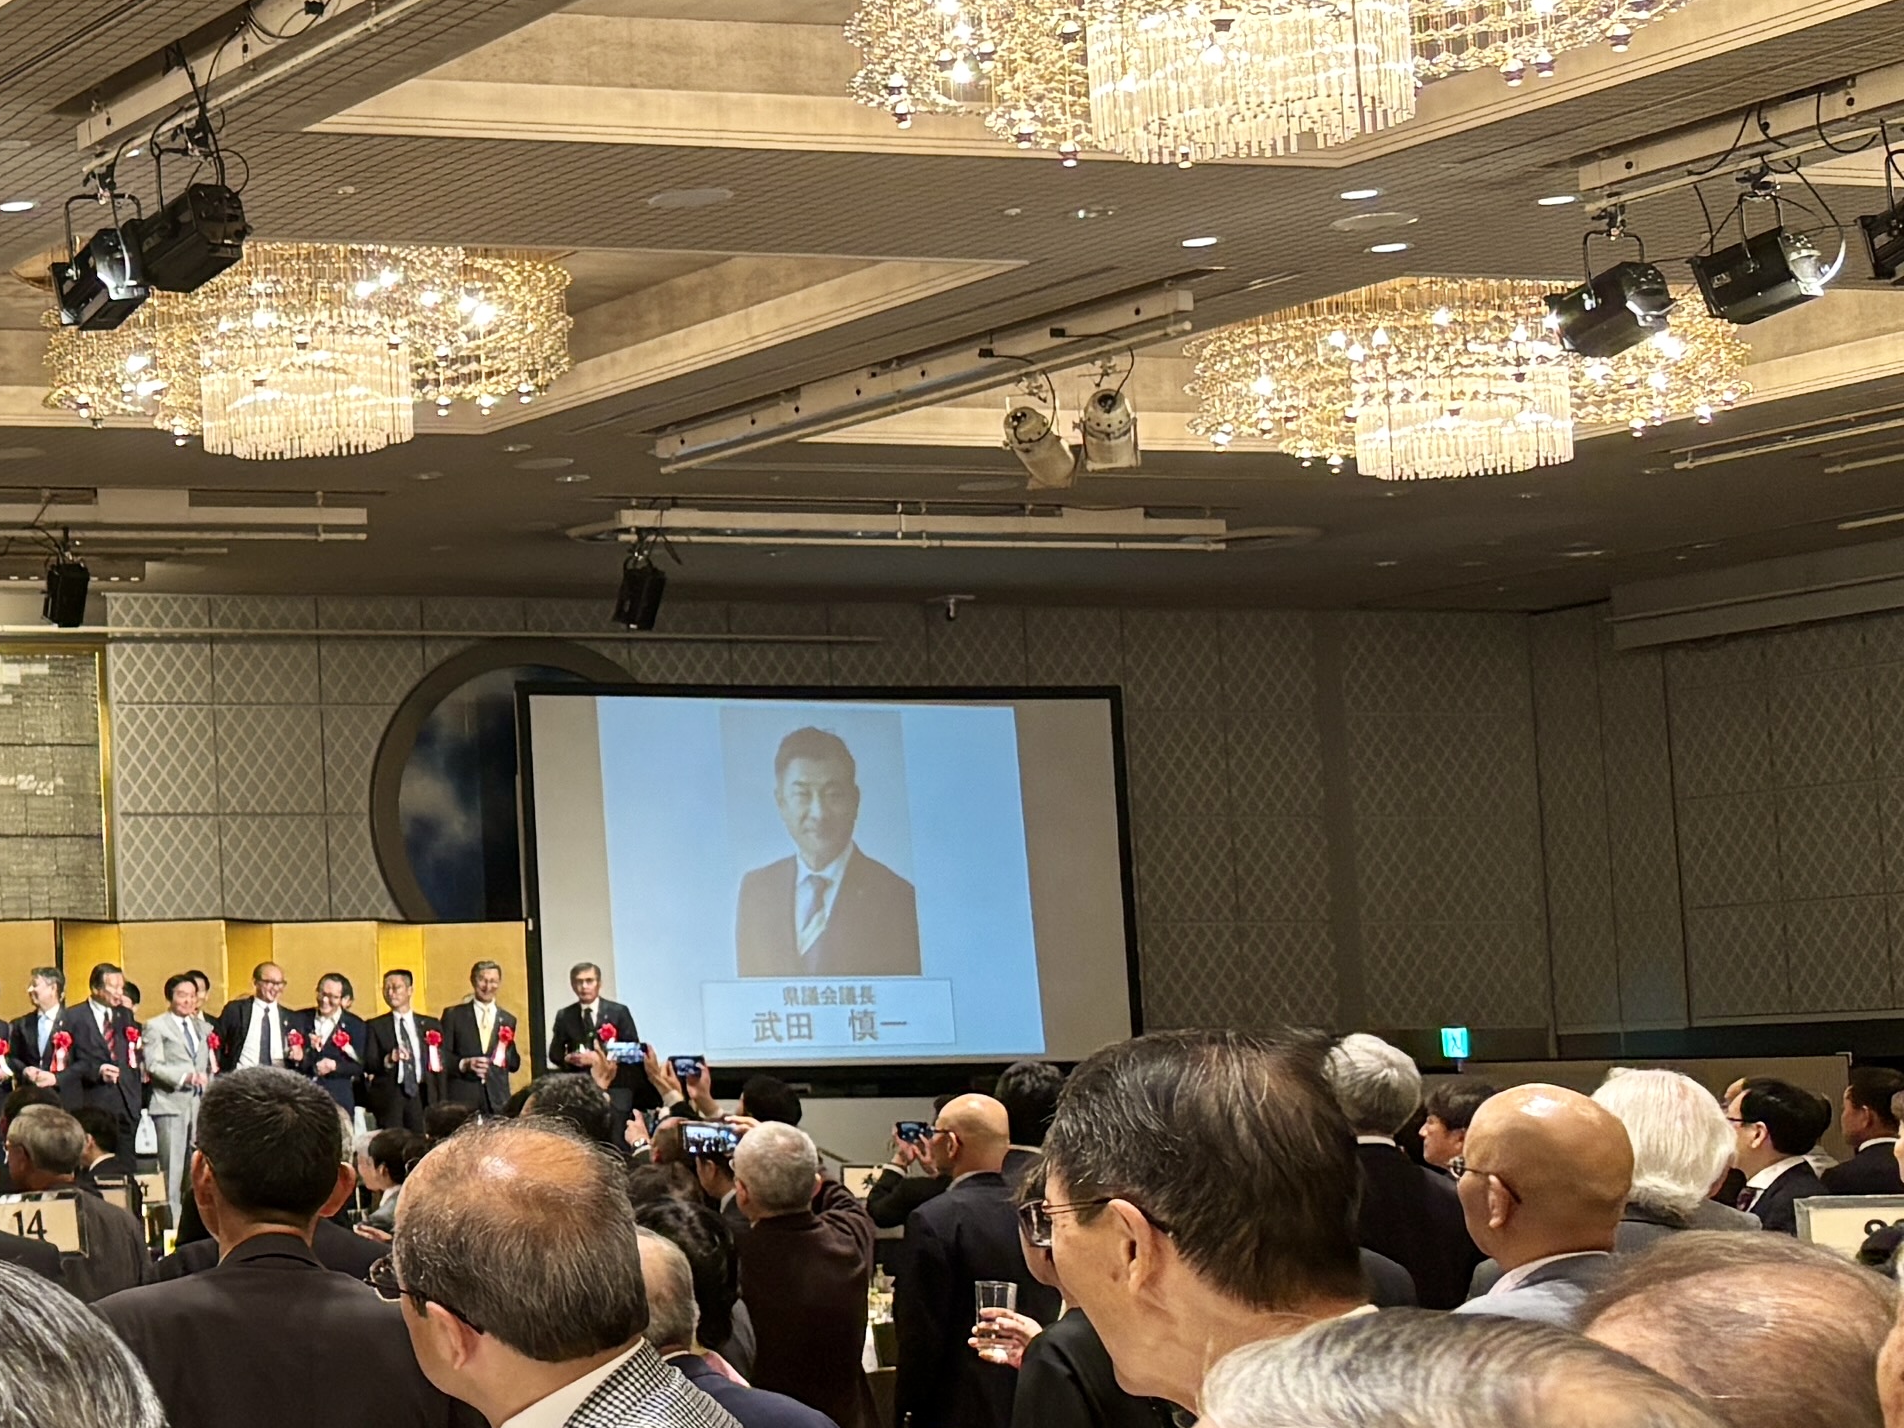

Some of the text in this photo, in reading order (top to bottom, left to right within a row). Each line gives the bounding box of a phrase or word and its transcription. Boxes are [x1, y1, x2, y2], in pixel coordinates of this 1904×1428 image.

[782, 985, 876, 1007] 県議会議長
[751, 1009, 908, 1042] 武田 慎一
[12, 1209, 47, 1240] 14
